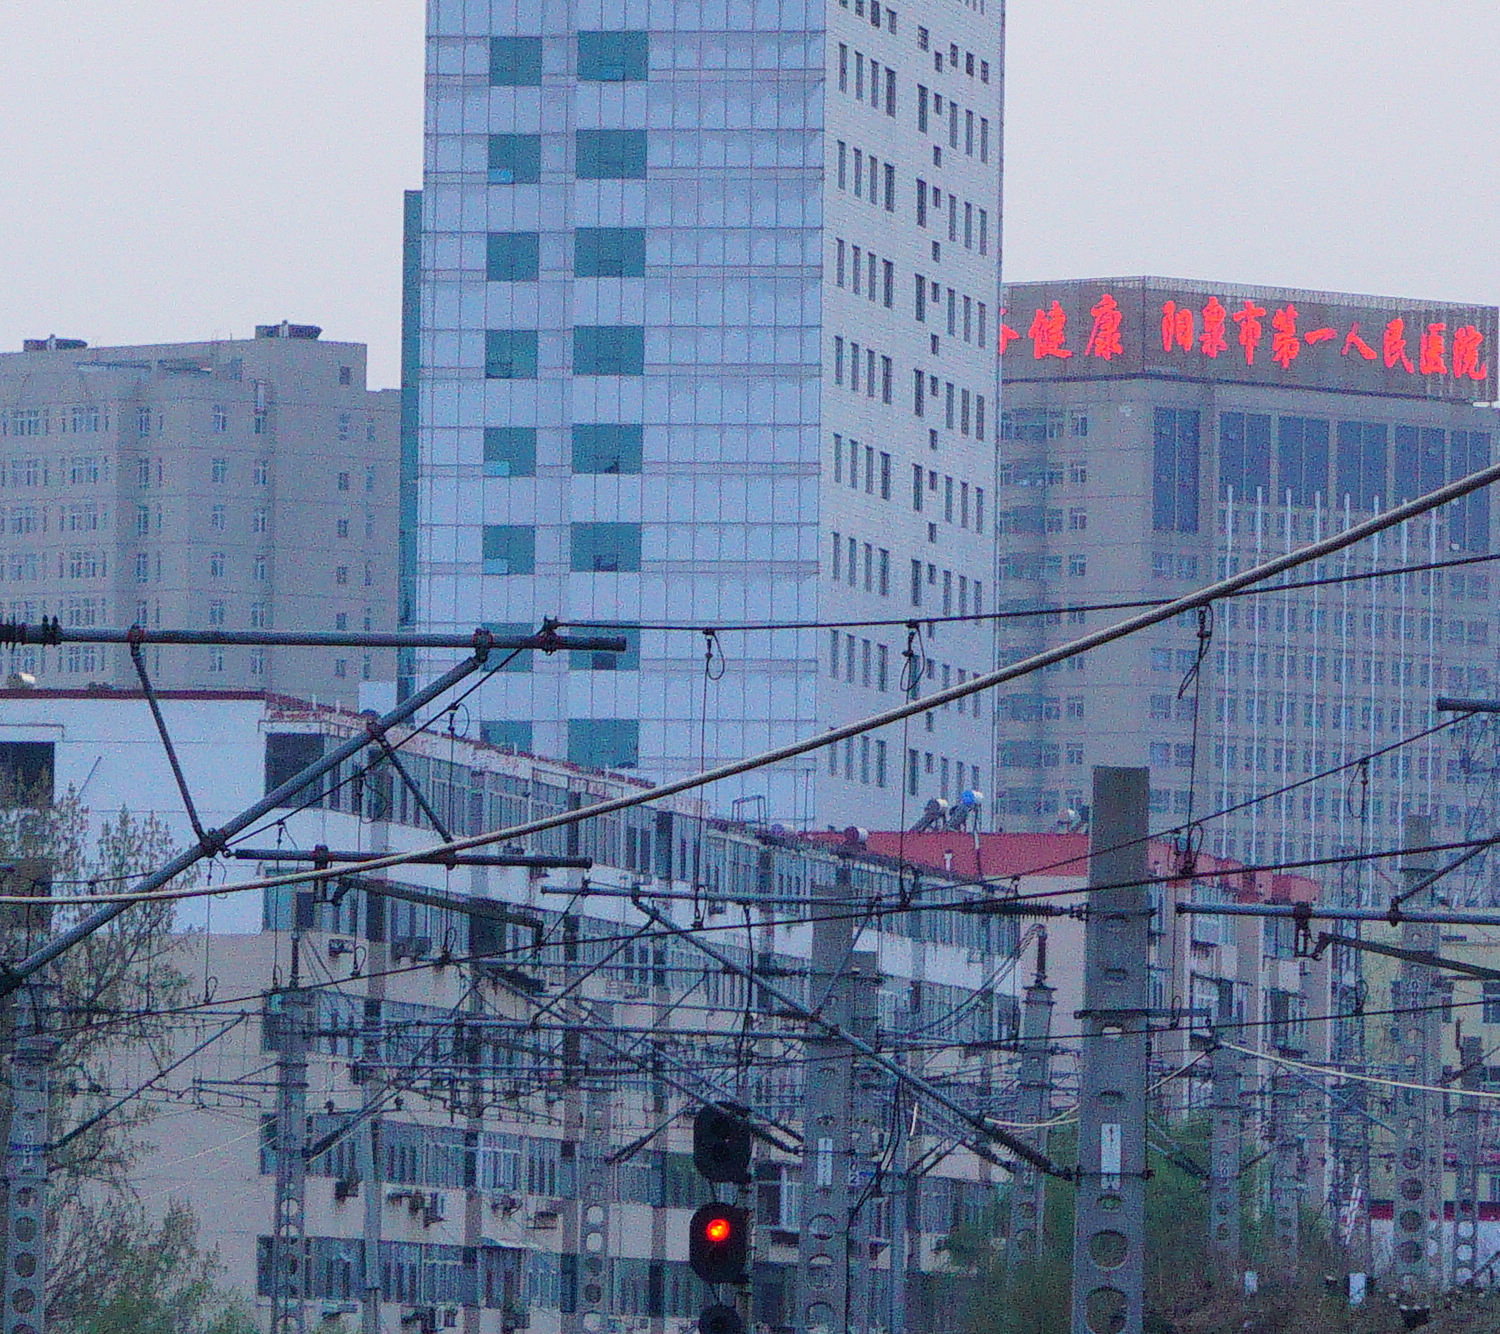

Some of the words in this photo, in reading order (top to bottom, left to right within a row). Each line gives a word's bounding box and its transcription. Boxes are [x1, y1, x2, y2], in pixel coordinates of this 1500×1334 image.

[1162, 296, 1487, 381] 阳泉市第一人民医院
